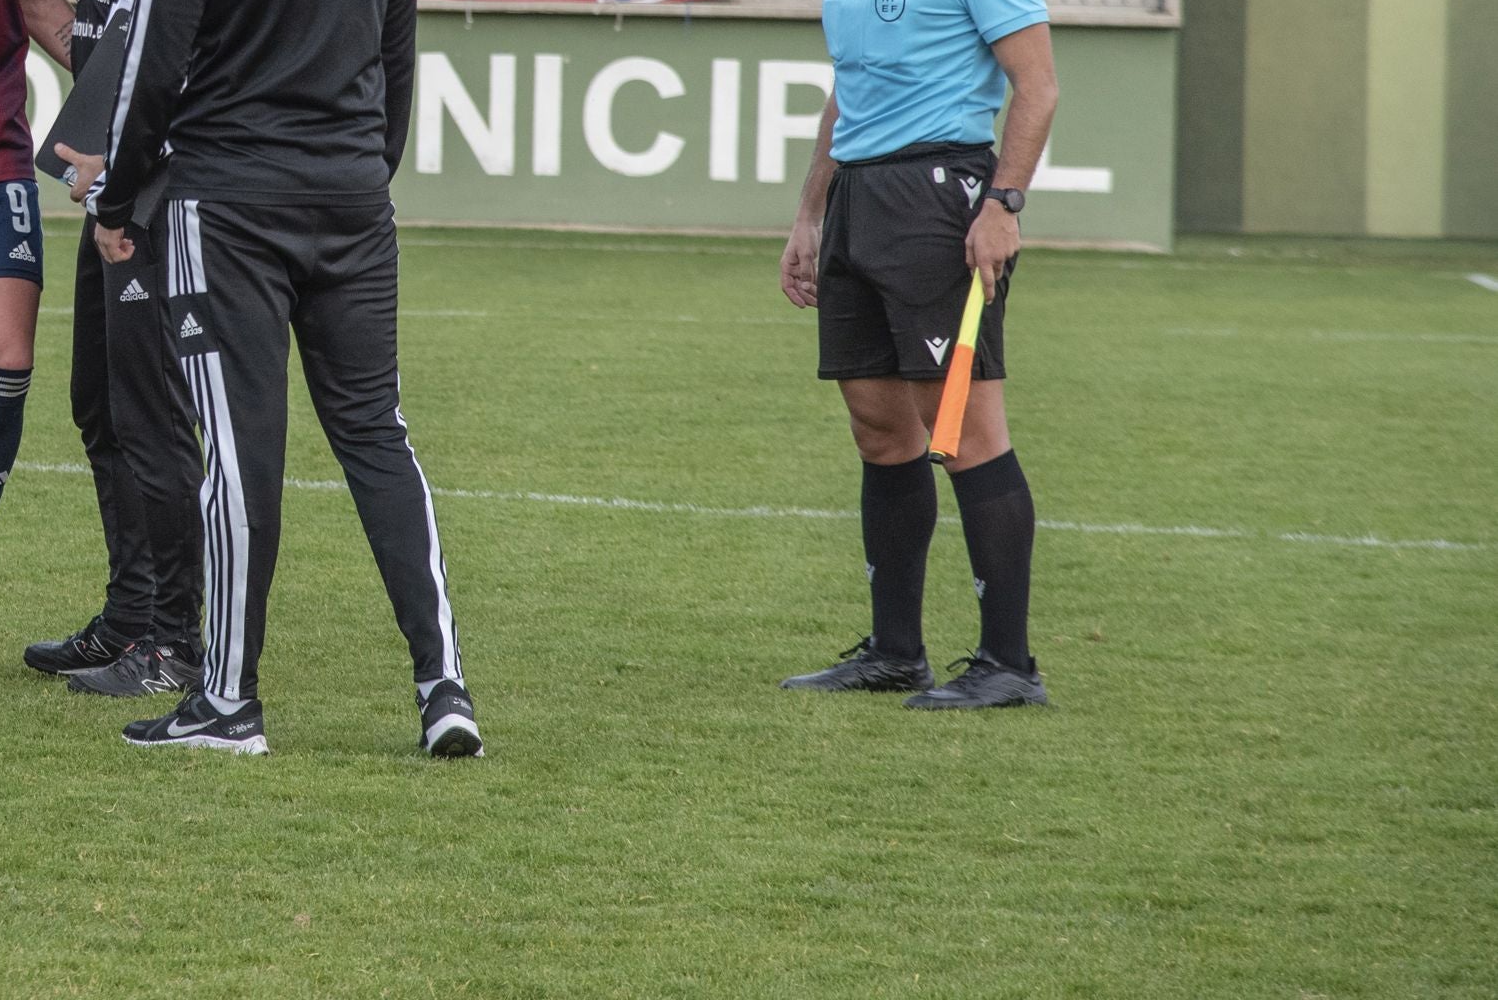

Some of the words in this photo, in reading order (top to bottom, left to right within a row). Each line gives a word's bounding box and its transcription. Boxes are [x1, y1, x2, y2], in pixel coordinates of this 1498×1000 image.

[6, 183, 32, 234] 9
[9, 251, 36, 263] adidas
[119, 291, 149, 302] adidas
[180, 326, 203, 339] adidas
